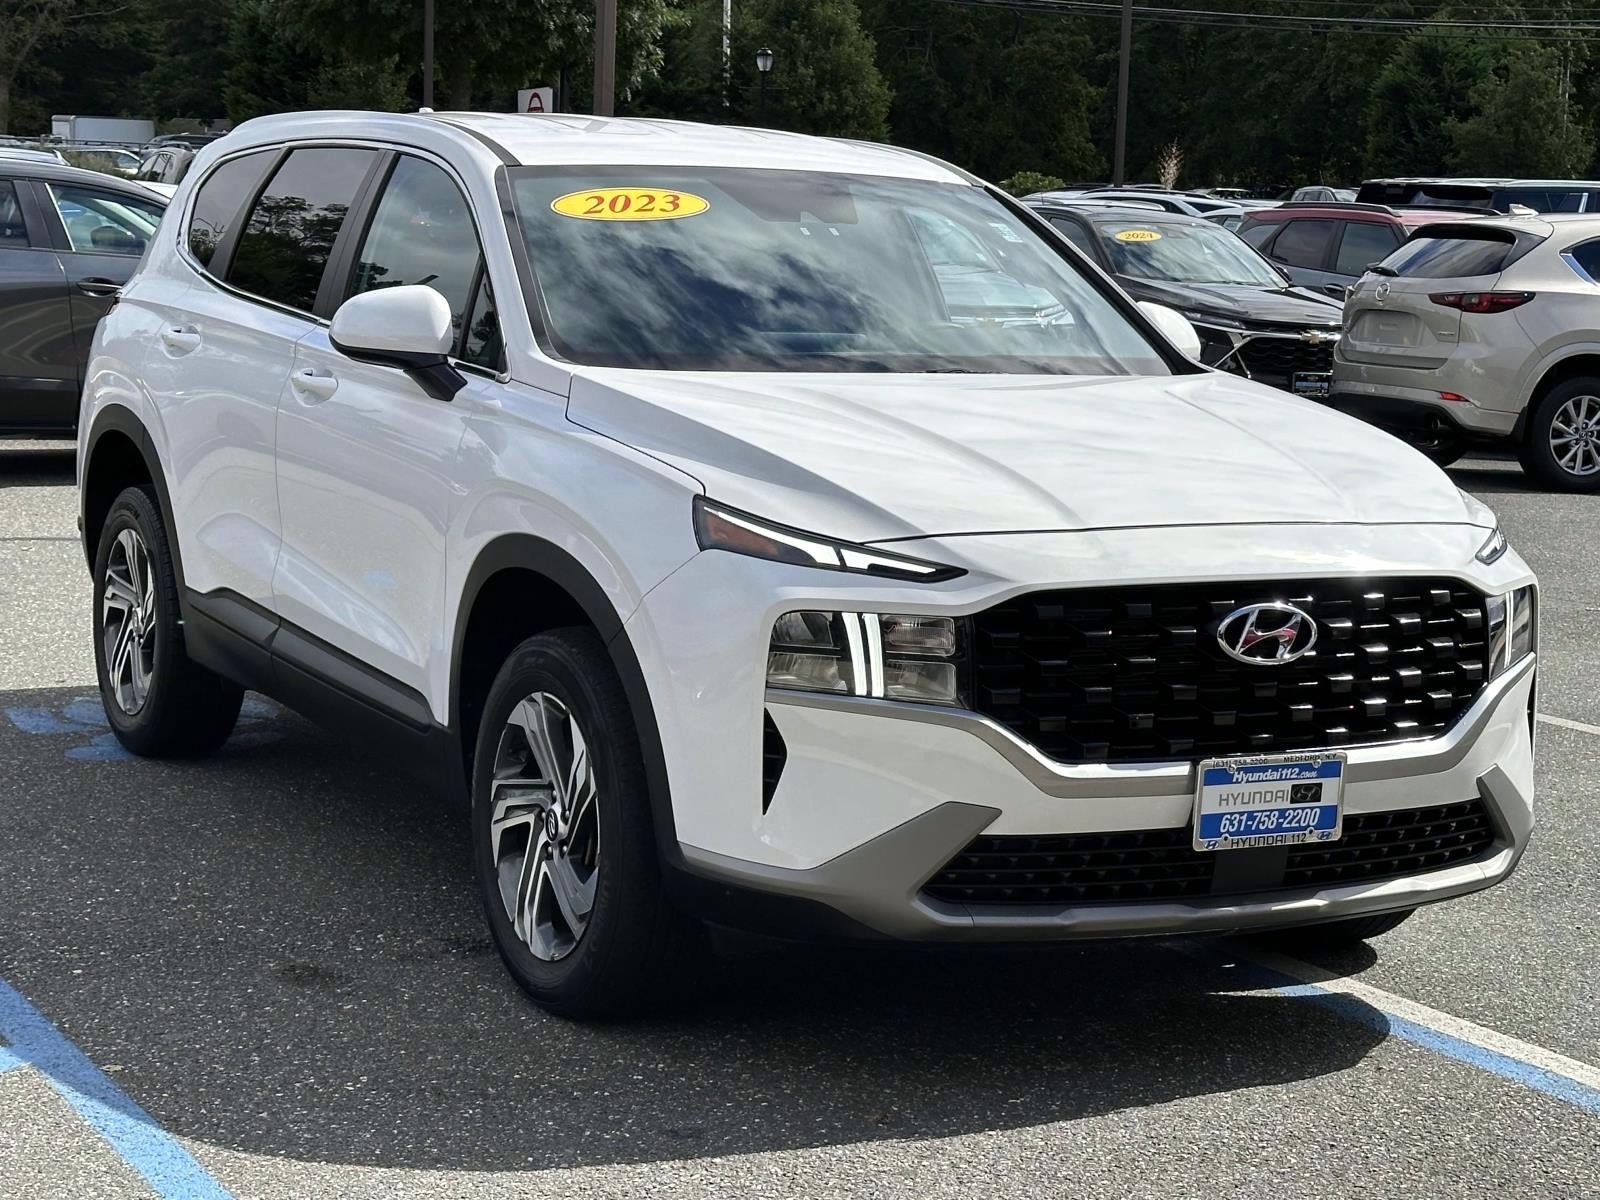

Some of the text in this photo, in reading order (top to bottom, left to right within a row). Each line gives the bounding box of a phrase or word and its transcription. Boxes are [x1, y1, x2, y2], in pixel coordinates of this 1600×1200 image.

[583, 194, 681, 215] 2023
[1232, 768, 1318, 784] Hyundai112.com
[1219, 789, 1288, 806] HYUNDAI
[1220, 808, 1320, 832] 631-758-2200
[1230, 833, 1306, 848] HYUNDAI 112
